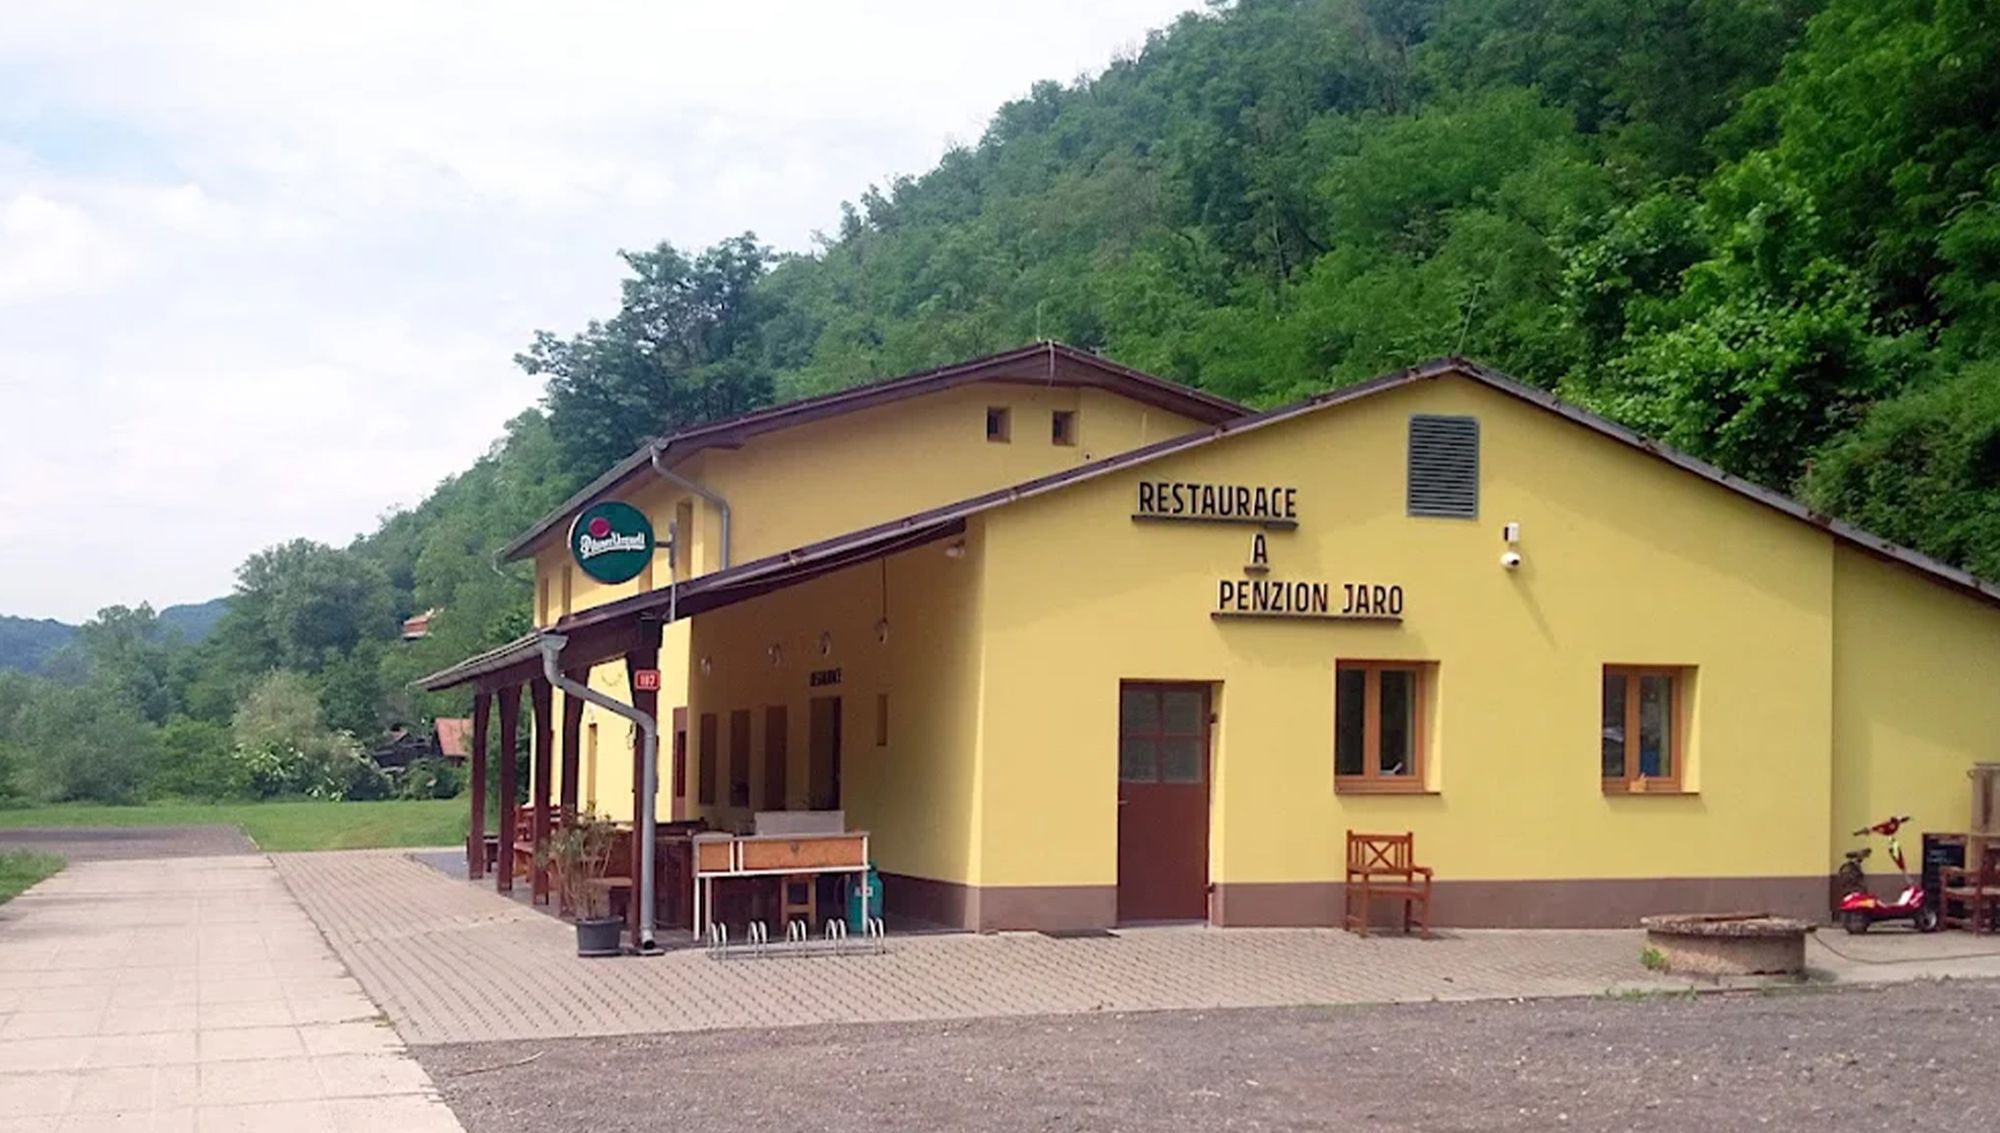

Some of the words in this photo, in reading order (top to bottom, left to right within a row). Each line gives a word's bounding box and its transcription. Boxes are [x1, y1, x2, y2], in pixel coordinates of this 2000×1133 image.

[1139, 482, 1296, 518] RESTAURACE
[1252, 534, 1268, 564] A
[1219, 580, 1328, 612] PENZION
[1342, 583, 1403, 615] JARO
